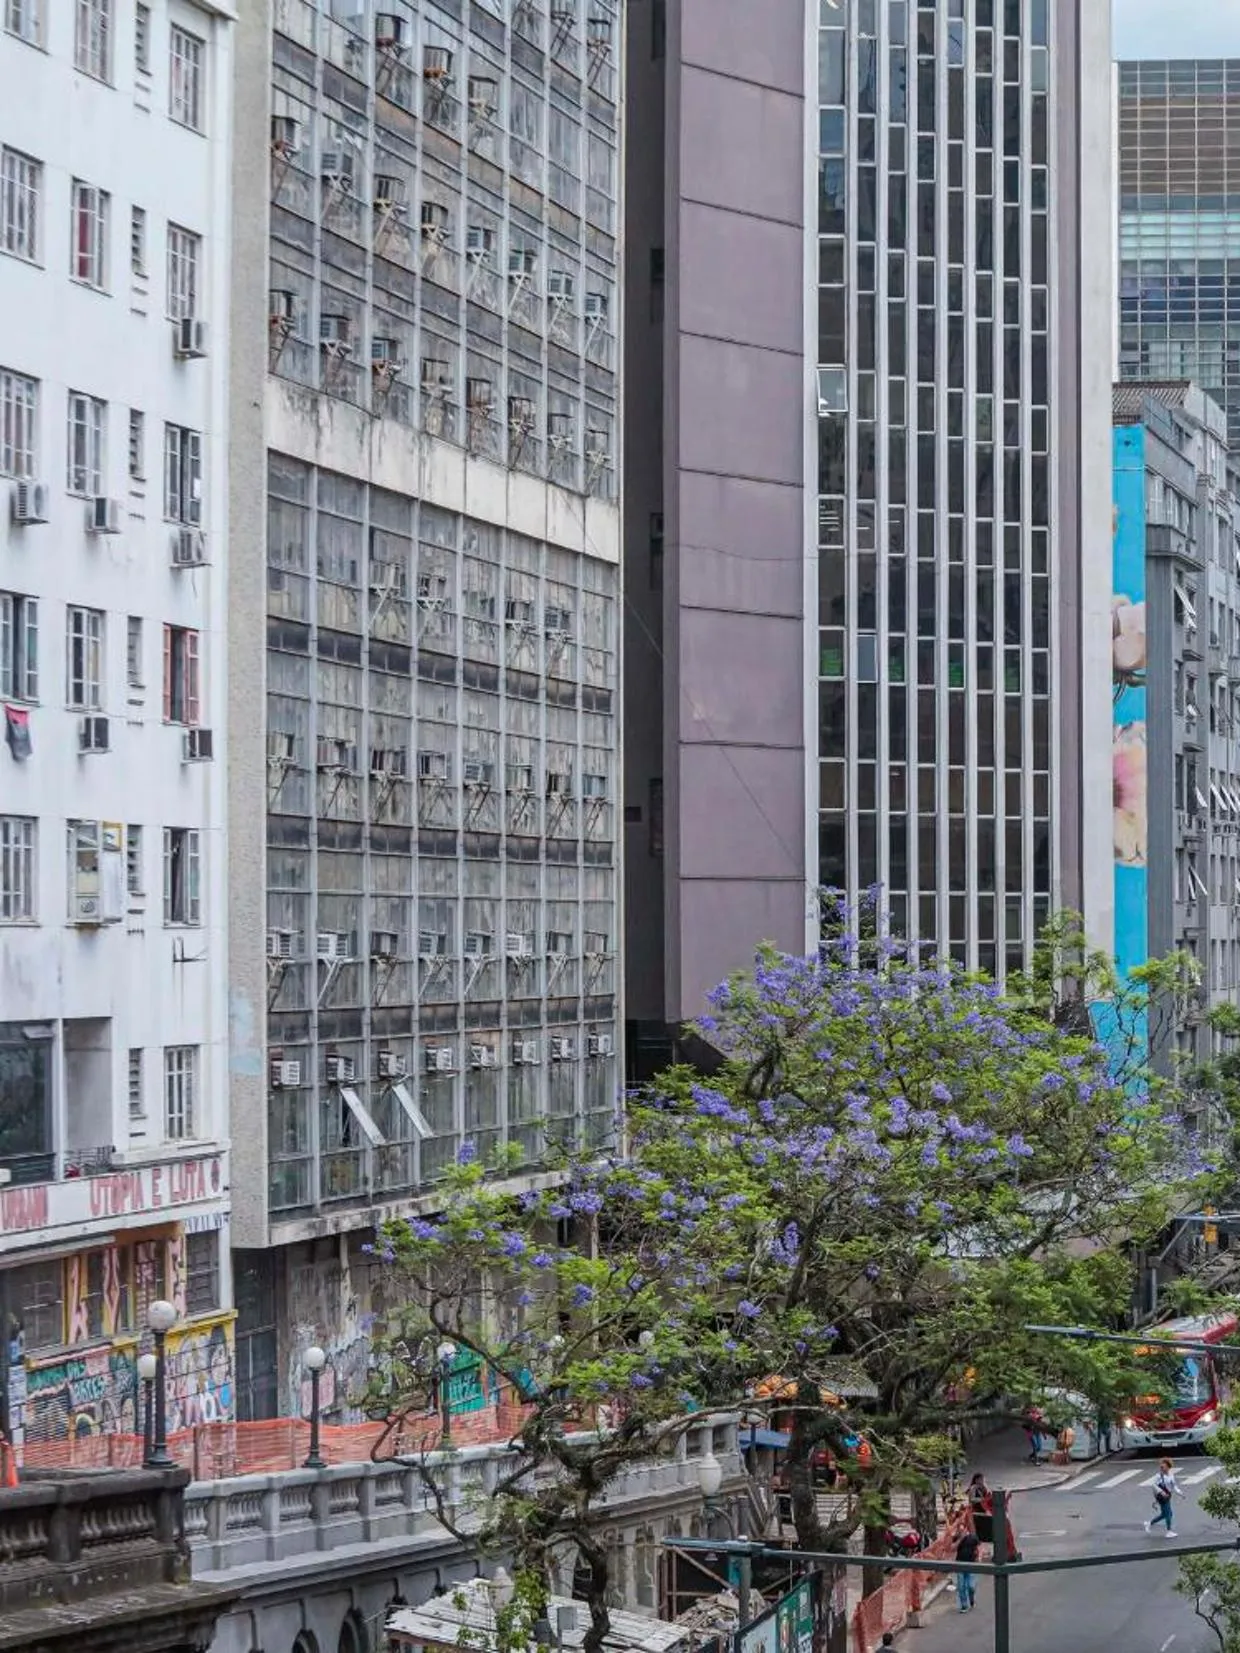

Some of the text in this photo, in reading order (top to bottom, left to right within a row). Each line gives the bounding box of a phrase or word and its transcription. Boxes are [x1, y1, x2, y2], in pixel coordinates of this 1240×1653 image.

[89, 1171, 144, 1217] UTOPIA
[152, 1168, 162, 1208] E
[170, 1159, 206, 1202] LUTA
